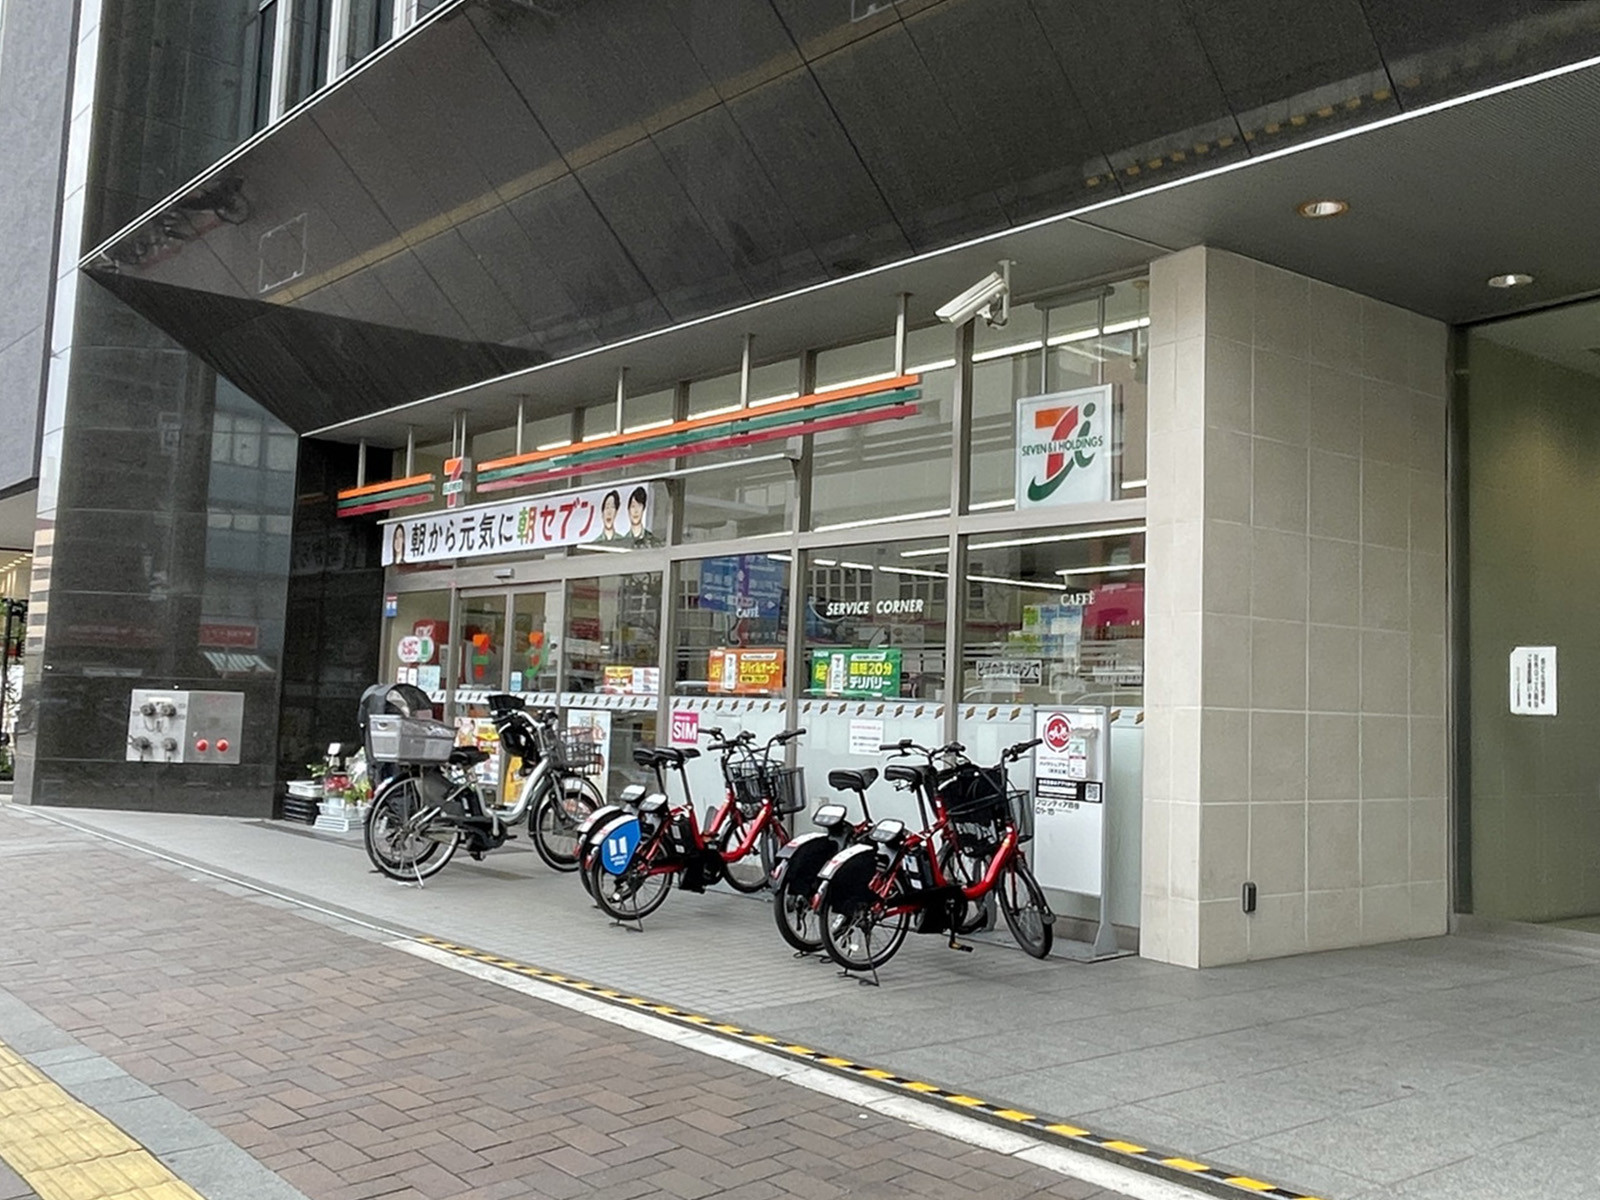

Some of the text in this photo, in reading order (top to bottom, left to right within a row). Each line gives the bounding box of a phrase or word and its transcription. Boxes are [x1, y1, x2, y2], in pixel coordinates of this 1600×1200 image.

[1059, 436, 1103, 451] HOLDINGS
[410, 497, 594, 557] 朝から元気に朝セブン
[826, 599, 924, 616] SERVICE CORNER
[849, 676, 892, 689] デリバリー
[673, 721, 697, 740] SIM
